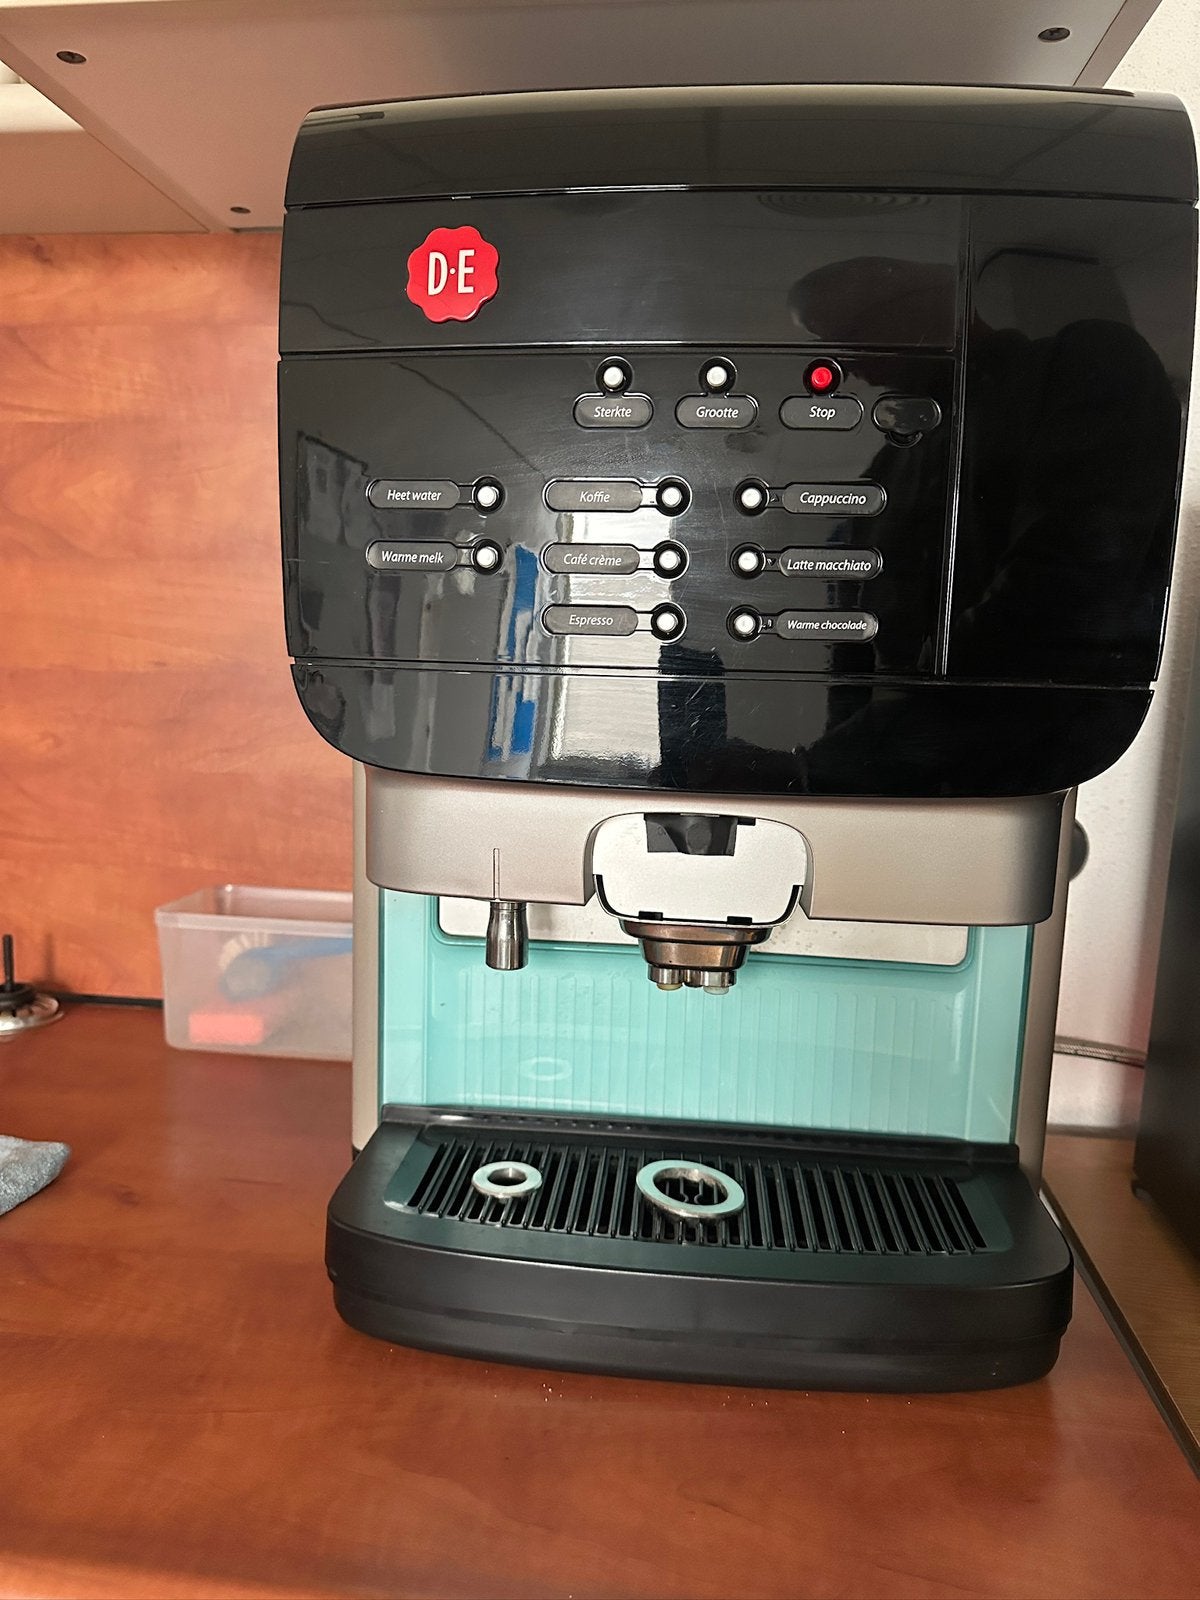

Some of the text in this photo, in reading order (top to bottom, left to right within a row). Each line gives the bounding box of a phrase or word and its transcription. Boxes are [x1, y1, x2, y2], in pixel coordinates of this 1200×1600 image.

[593, 405, 632, 418] Sterkte
[696, 405, 739, 419] Grootte
[809, 405, 836, 420] Stop
[387, 489, 442, 501] Heet water
[579, 491, 611, 503] Koffie
[799, 492, 867, 507] Cappuccino
[381, 550, 444, 564] Warme melk
[563, 553, 622, 566] Café crème
[787, 559, 872, 571] Latte macchiato
[569, 614, 614, 626] Espresso
[787, 619, 868, 631] Warme chocolade
